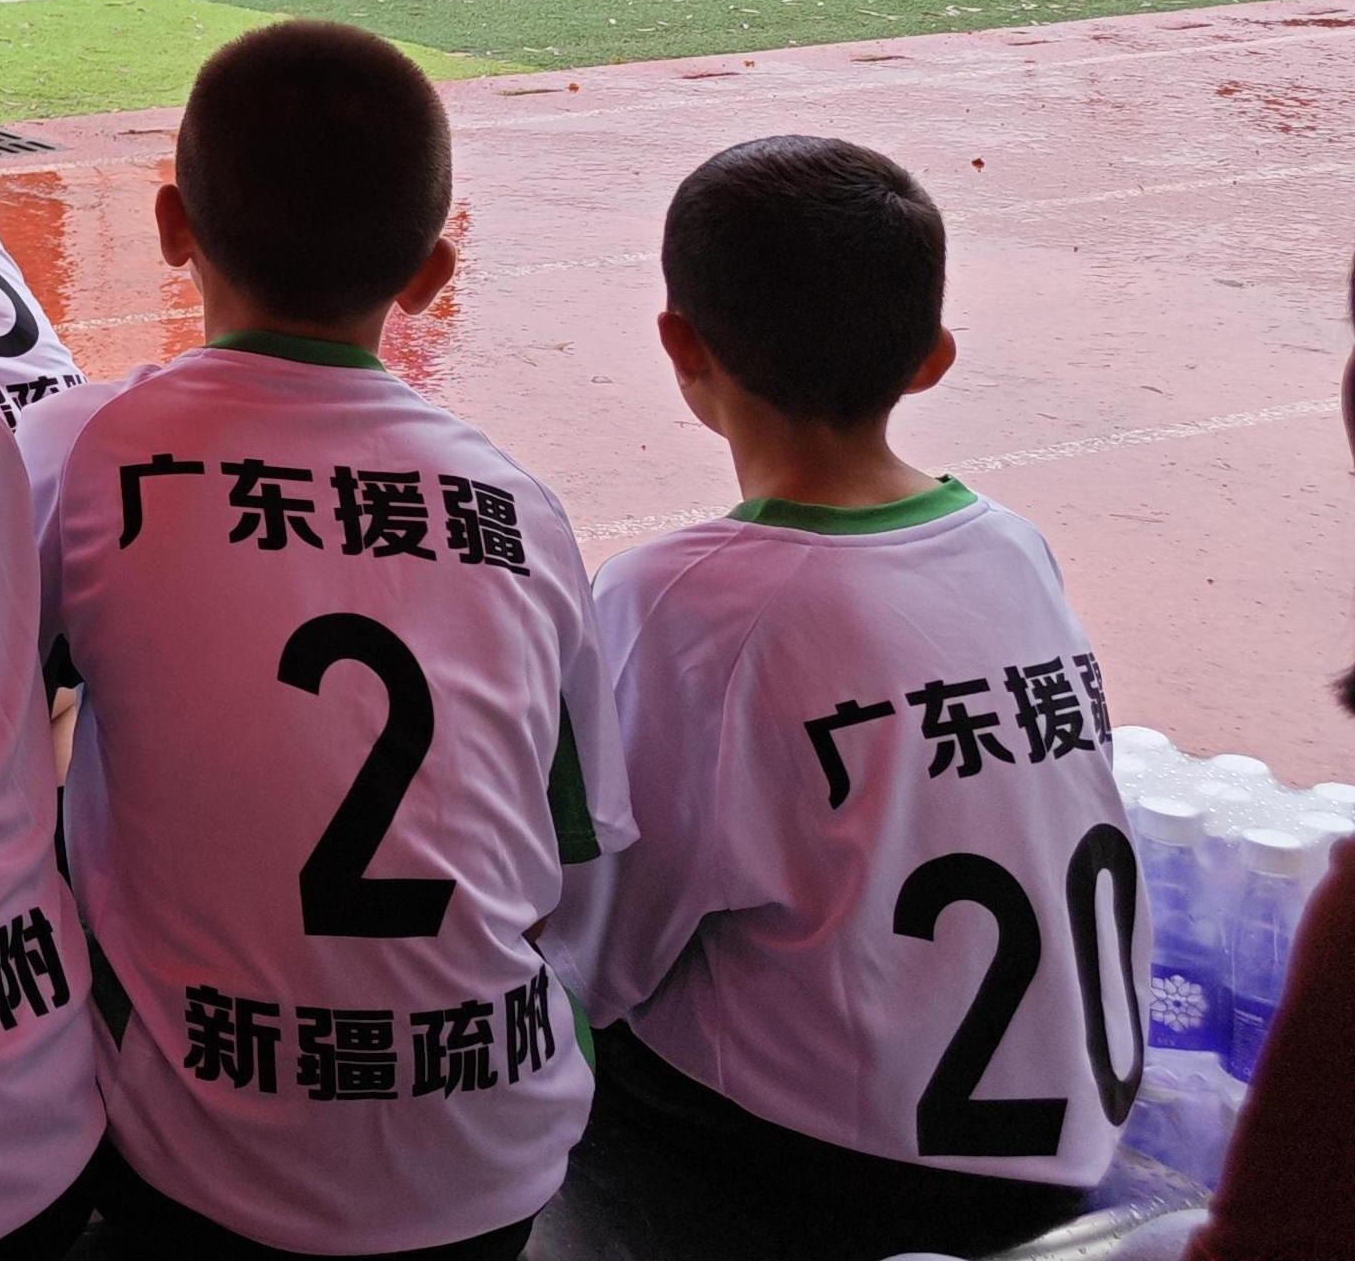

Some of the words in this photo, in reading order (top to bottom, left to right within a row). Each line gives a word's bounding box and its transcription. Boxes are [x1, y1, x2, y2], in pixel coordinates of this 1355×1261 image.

[119, 453, 531, 577] 广东援疆
[277, 612, 457, 938] 2
[182, 963, 556, 1102] 新疆疏附
[892, 823, 1145, 1157] 20
